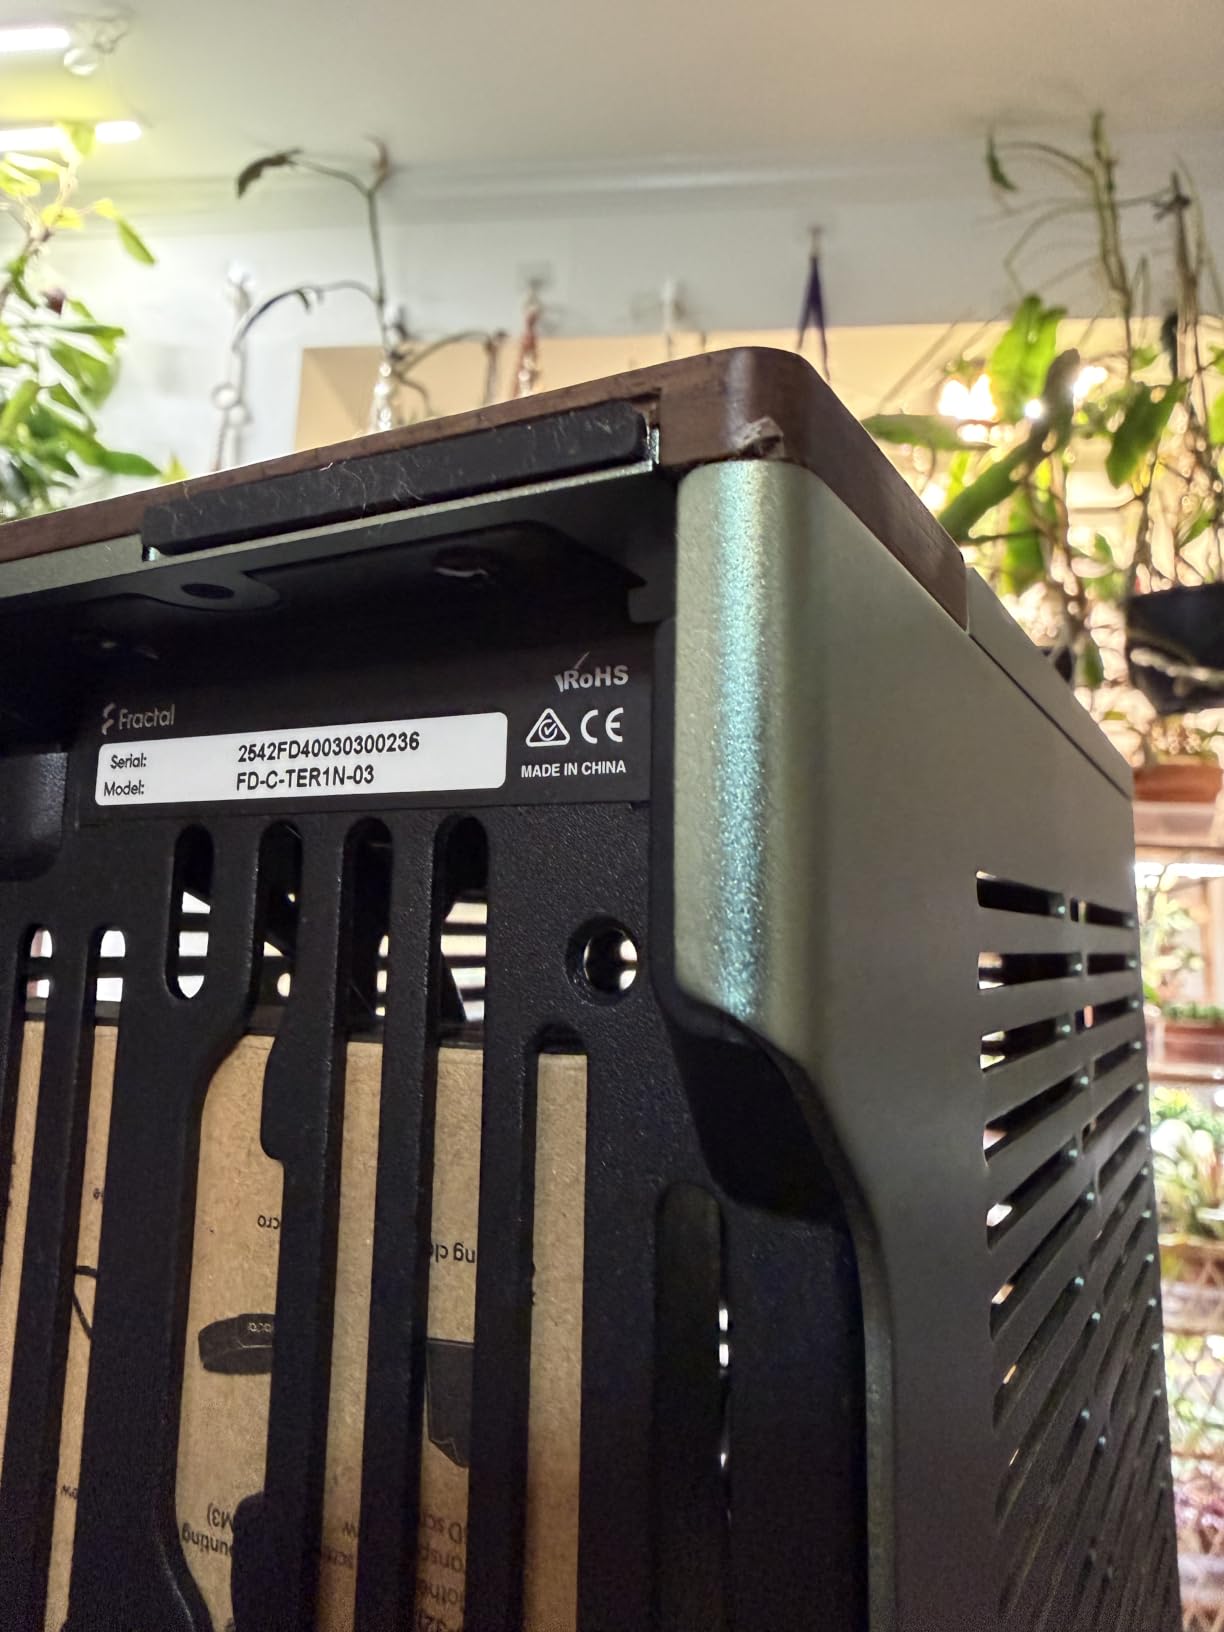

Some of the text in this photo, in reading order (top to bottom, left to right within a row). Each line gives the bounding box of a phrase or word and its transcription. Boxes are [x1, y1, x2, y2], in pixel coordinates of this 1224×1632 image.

[562, 665, 629, 690] RoHS
[119, 704, 176, 730] Fractal
[110, 731, 420, 769] Serial: 2542FD40030300236
[103, 764, 374, 796] Model: FD-C-TER1N-03
[521, 760, 627, 778] MADE IN CHINA
